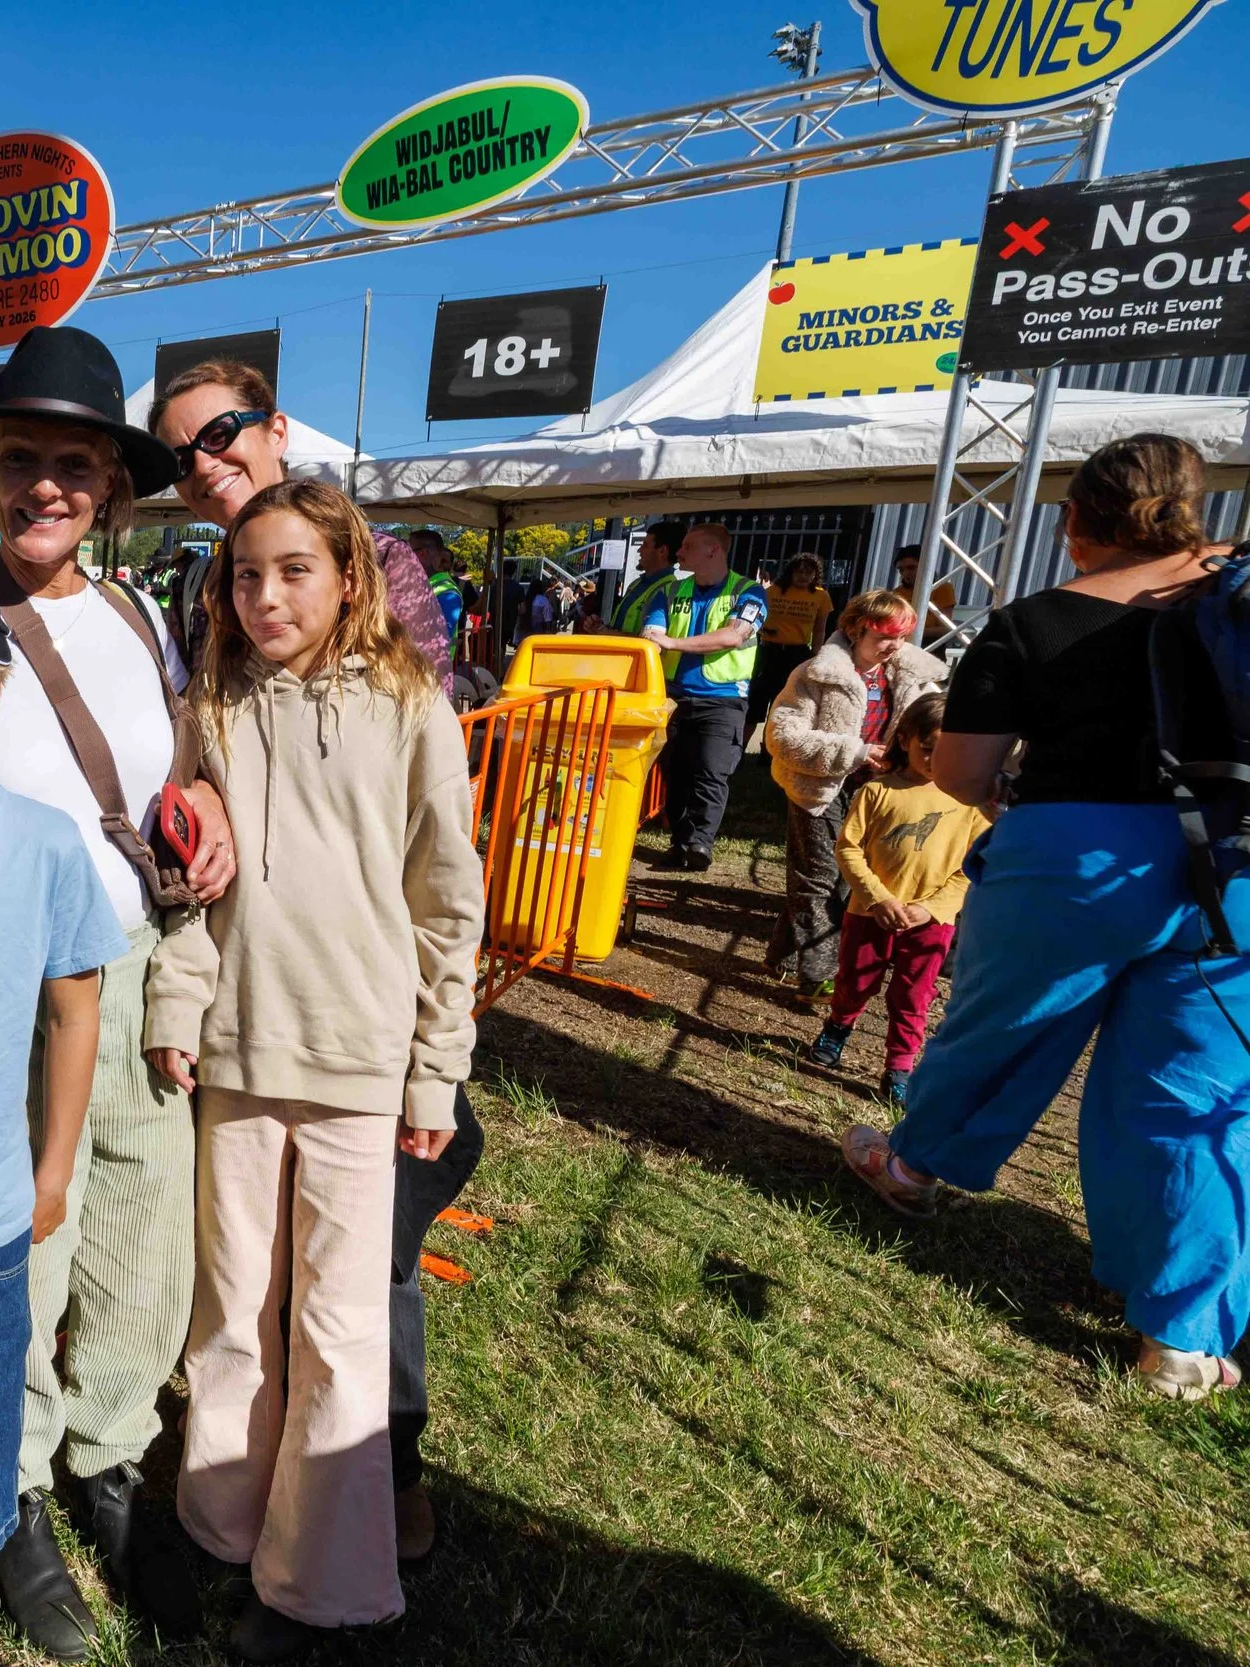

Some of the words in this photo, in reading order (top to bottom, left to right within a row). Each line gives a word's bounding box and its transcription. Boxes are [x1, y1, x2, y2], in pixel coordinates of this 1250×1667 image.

[931, 0, 1134, 79] TUNES
[395, 100, 511, 168] WIDJABUL/
[31, 143, 76, 176] NIGHTS
[366, 161, 444, 211] WIA-BAL
[449, 125, 552, 185] COUNTRY
[1091, 200, 1191, 250] No
[19, 278, 60, 308] 2480
[8, 309, 37, 327] 2026
[797, 300, 923, 330] MINORS
[930, 298, 955, 317] &
[1023, 311, 1073, 326] Once
[1078, 306, 1114, 321] You
[1120, 301, 1158, 317] Exit
[1164, 296, 1224, 314] Event
[780, 320, 965, 353] GUARDIANS
[1017, 330, 1051, 344] You
[1057, 322, 1127, 341] Cannot
[1132, 316, 1222, 335] Re-Enter
[464, 336, 561, 378] 18+
